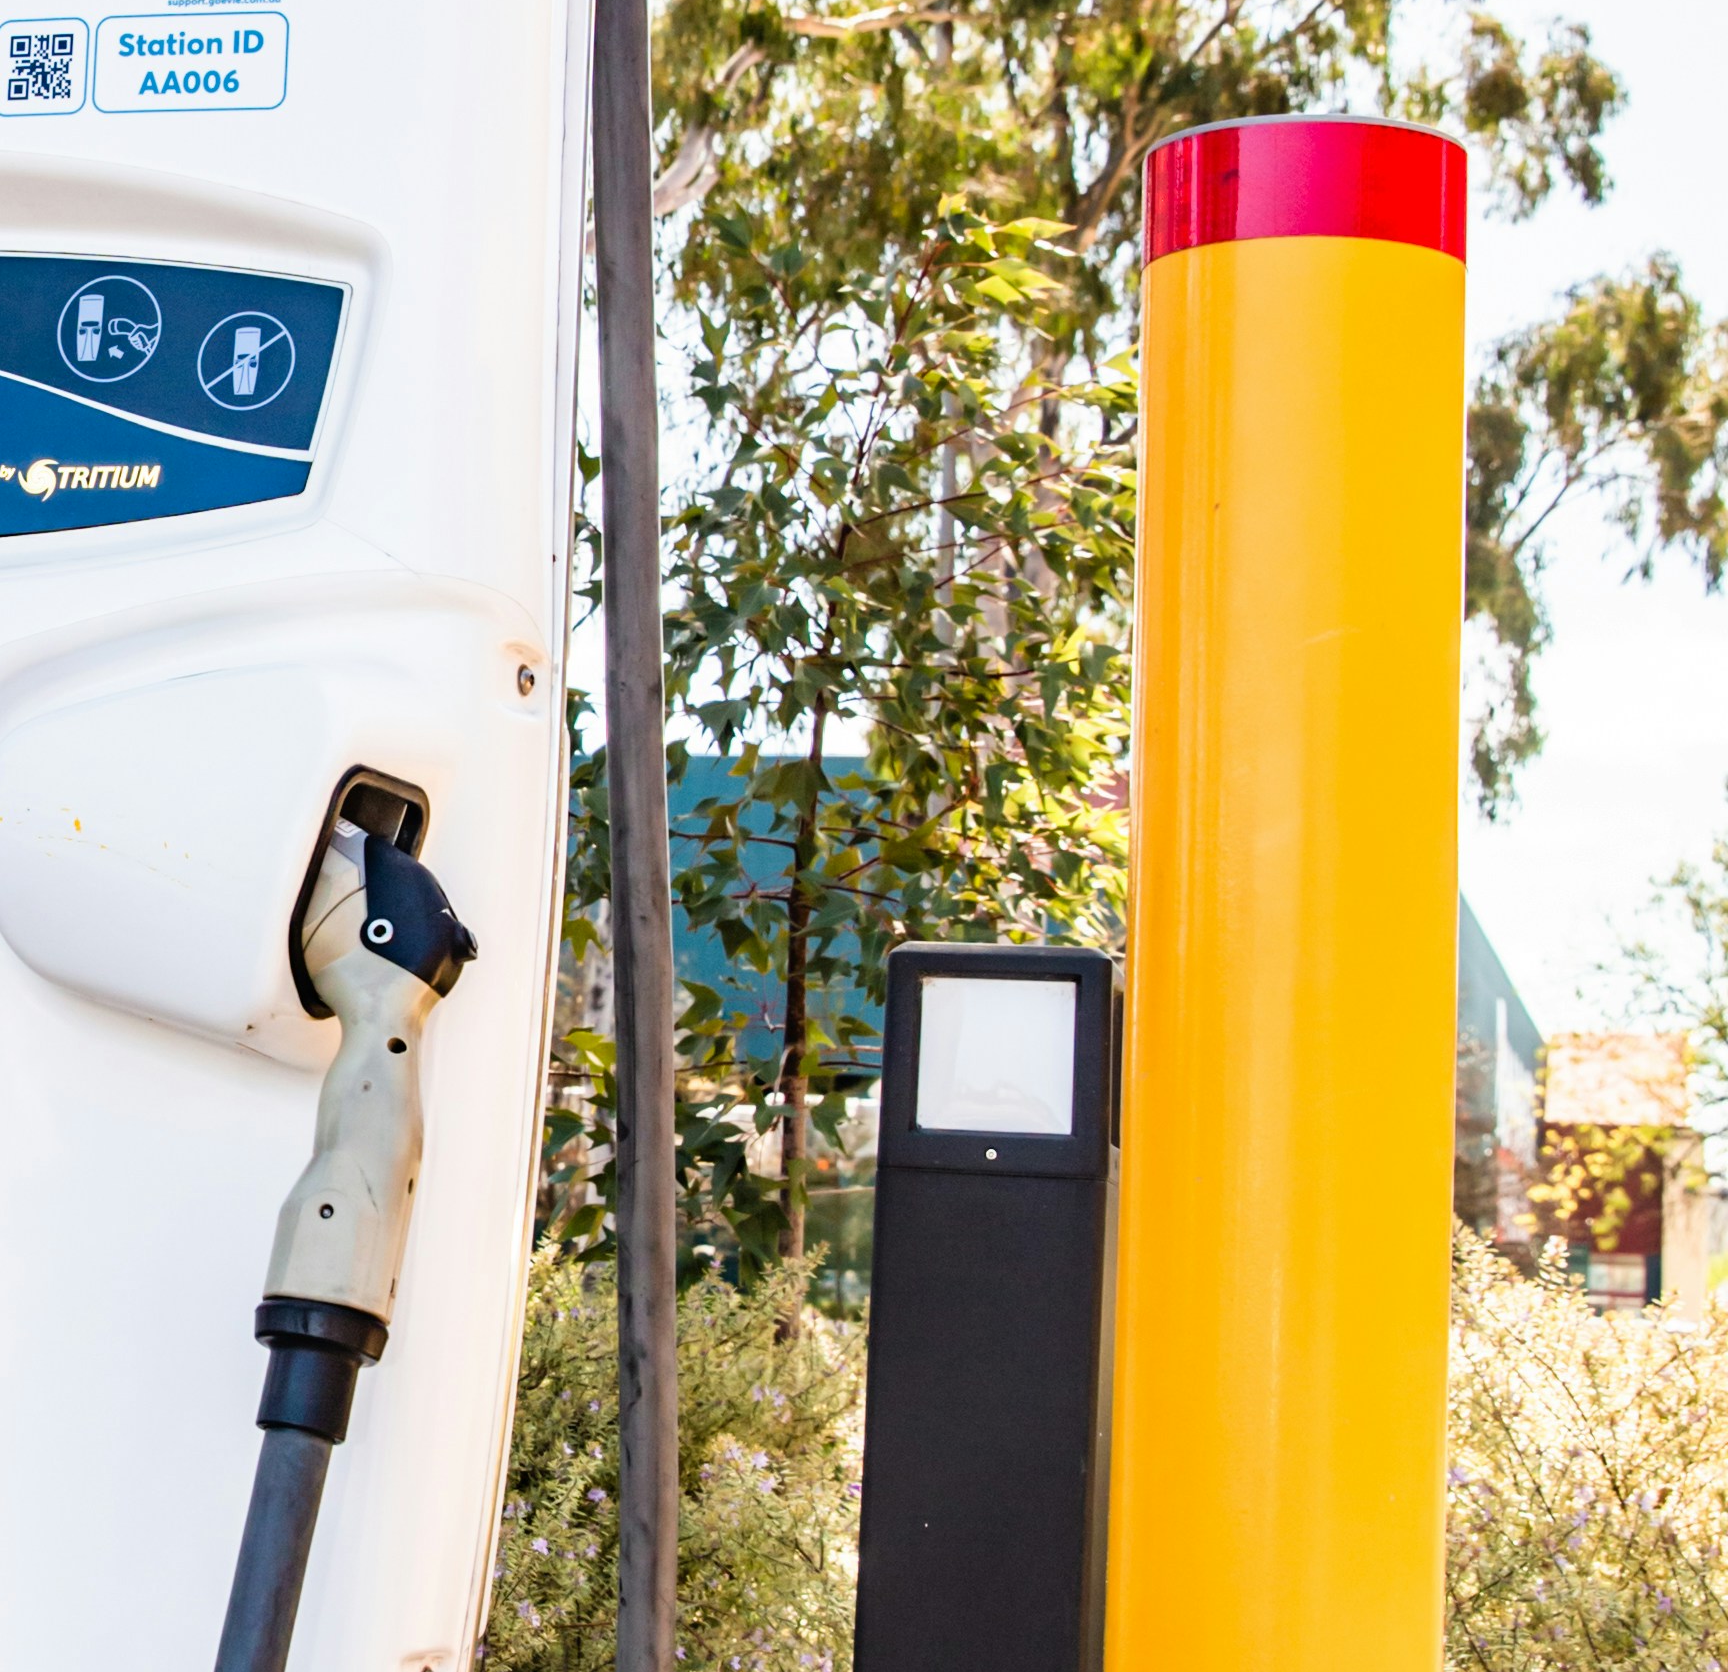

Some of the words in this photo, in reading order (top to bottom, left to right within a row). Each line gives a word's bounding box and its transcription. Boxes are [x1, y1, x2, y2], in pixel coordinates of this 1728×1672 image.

[118, 31, 223, 57] Station
[233, 30, 264, 54] ID
[138, 69, 240, 95] AA006
[56, 463, 162, 490] TRITIUM
